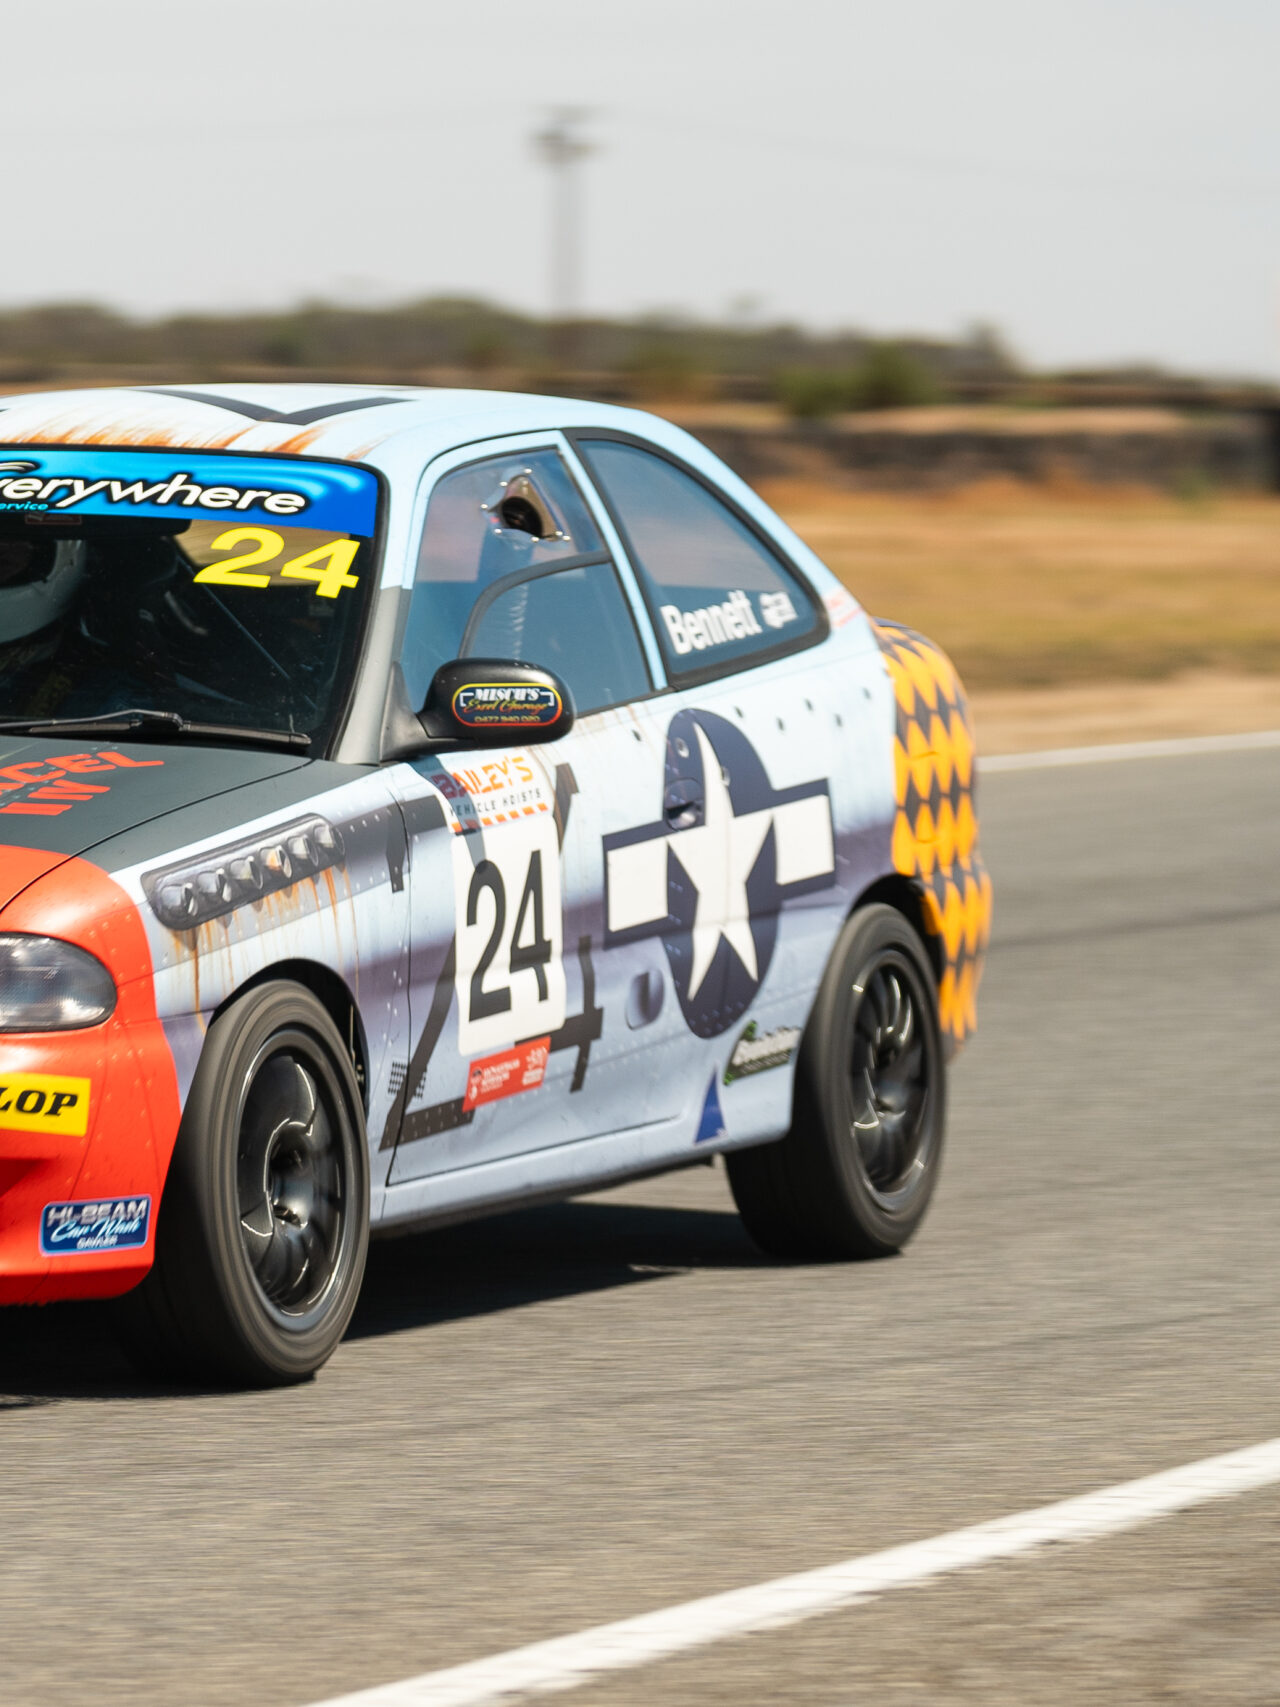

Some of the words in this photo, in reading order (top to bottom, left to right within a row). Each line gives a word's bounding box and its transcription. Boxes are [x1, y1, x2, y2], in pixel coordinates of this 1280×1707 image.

[193, 526, 361, 599] 24
[659, 589, 763, 656] Bennett
[430, 756, 534, 799] BAILEY'S
[449, 799, 496, 817] VEHICLE
[502, 787, 542, 806] HOISTS
[466, 849, 552, 1023] 24
[46, 1199, 148, 1228] HI-BEAM
[50, 1219, 91, 1243] Car
[91, 1215, 142, 1243] Wash
